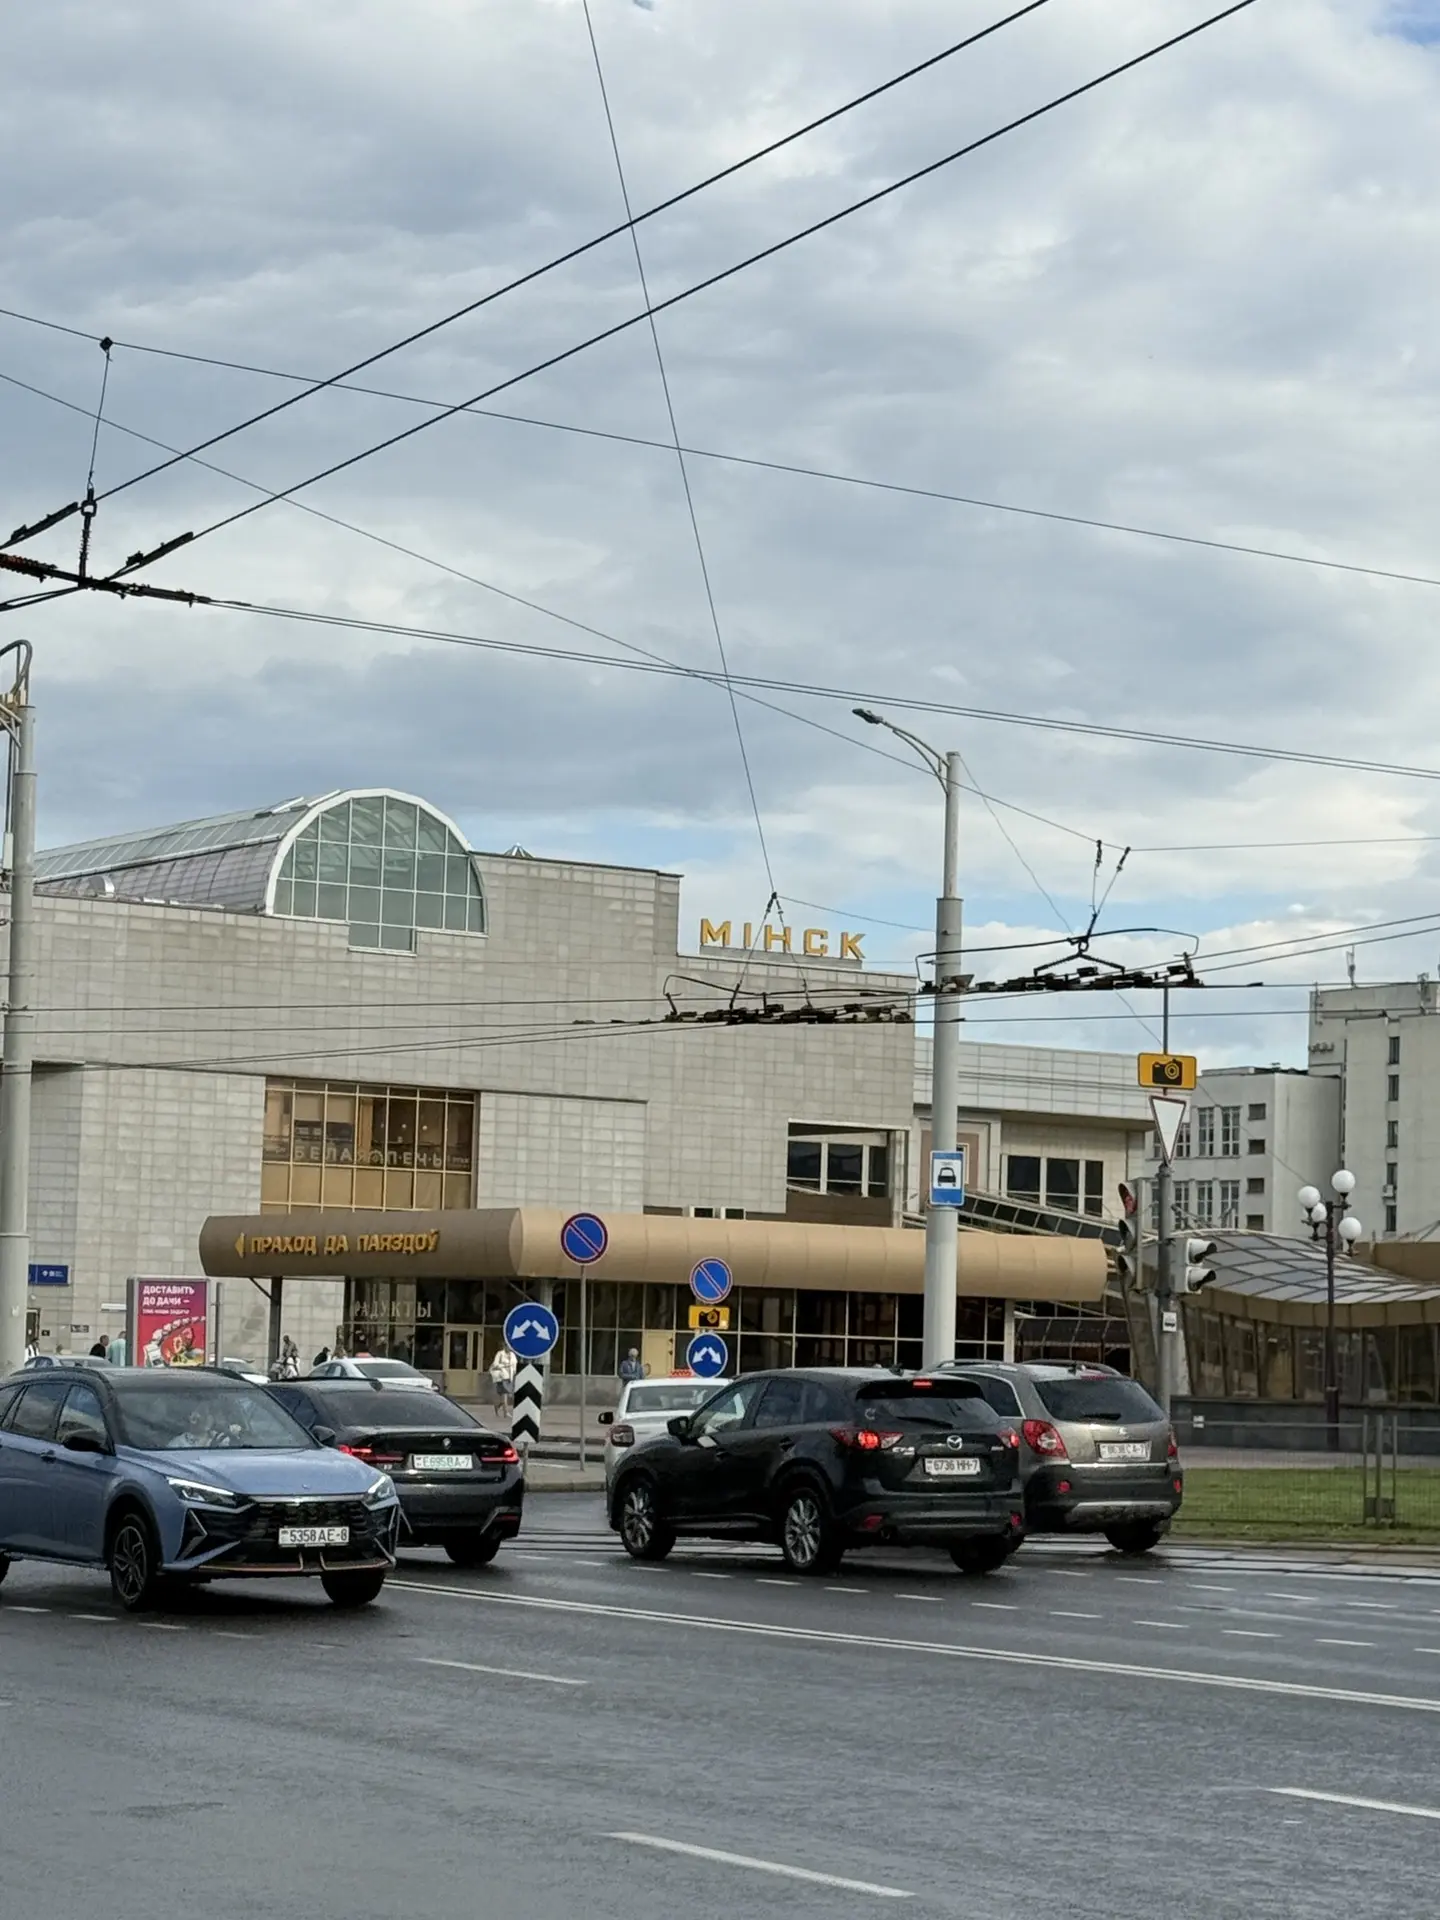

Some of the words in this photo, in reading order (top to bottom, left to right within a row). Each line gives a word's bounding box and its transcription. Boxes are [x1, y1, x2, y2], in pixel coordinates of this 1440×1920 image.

[700, 918, 866, 959] МІНСК
[251, 1236, 317, 1255] ПРАХОД
[324, 1235, 349, 1256] ДА
[357, 1228, 439, 1255] ПАЯЗДОЎ
[143, 1285, 195, 1295] ДОСТАВИТЬ
[142, 1296, 156, 1306] ДО
[157, 1296, 181, 1306] ДАЧИ
[349, 1300, 432, 1319] РАДУКТЫ
[290, 1529, 317, 1542] 5358
